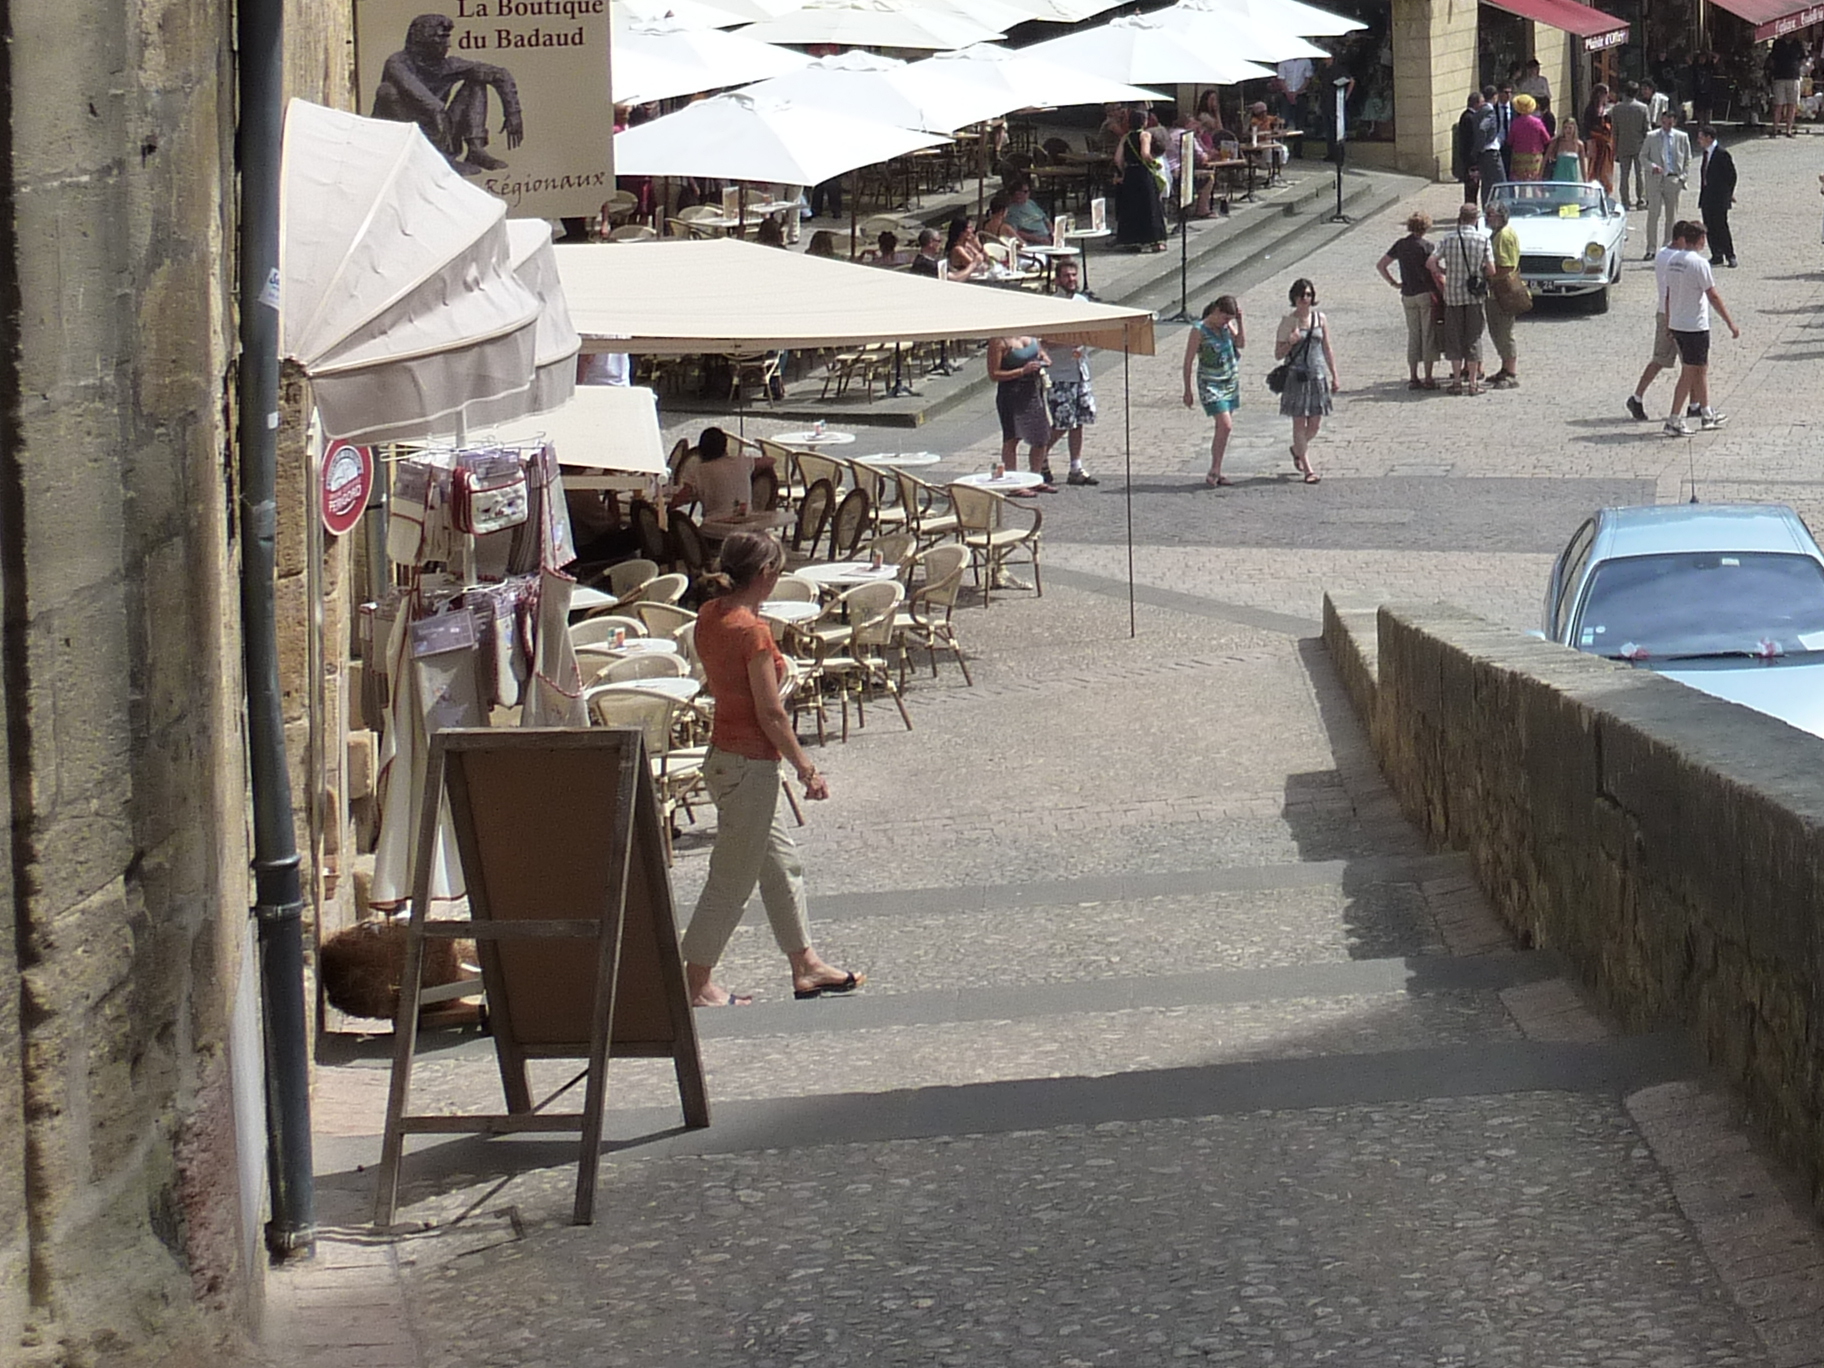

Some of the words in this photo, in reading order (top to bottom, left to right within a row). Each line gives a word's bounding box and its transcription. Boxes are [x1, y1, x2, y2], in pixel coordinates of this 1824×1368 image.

[458, 28, 487, 50] du
[494, 26, 585, 50] Badaud
[485, 171, 606, 208] Régionaux
